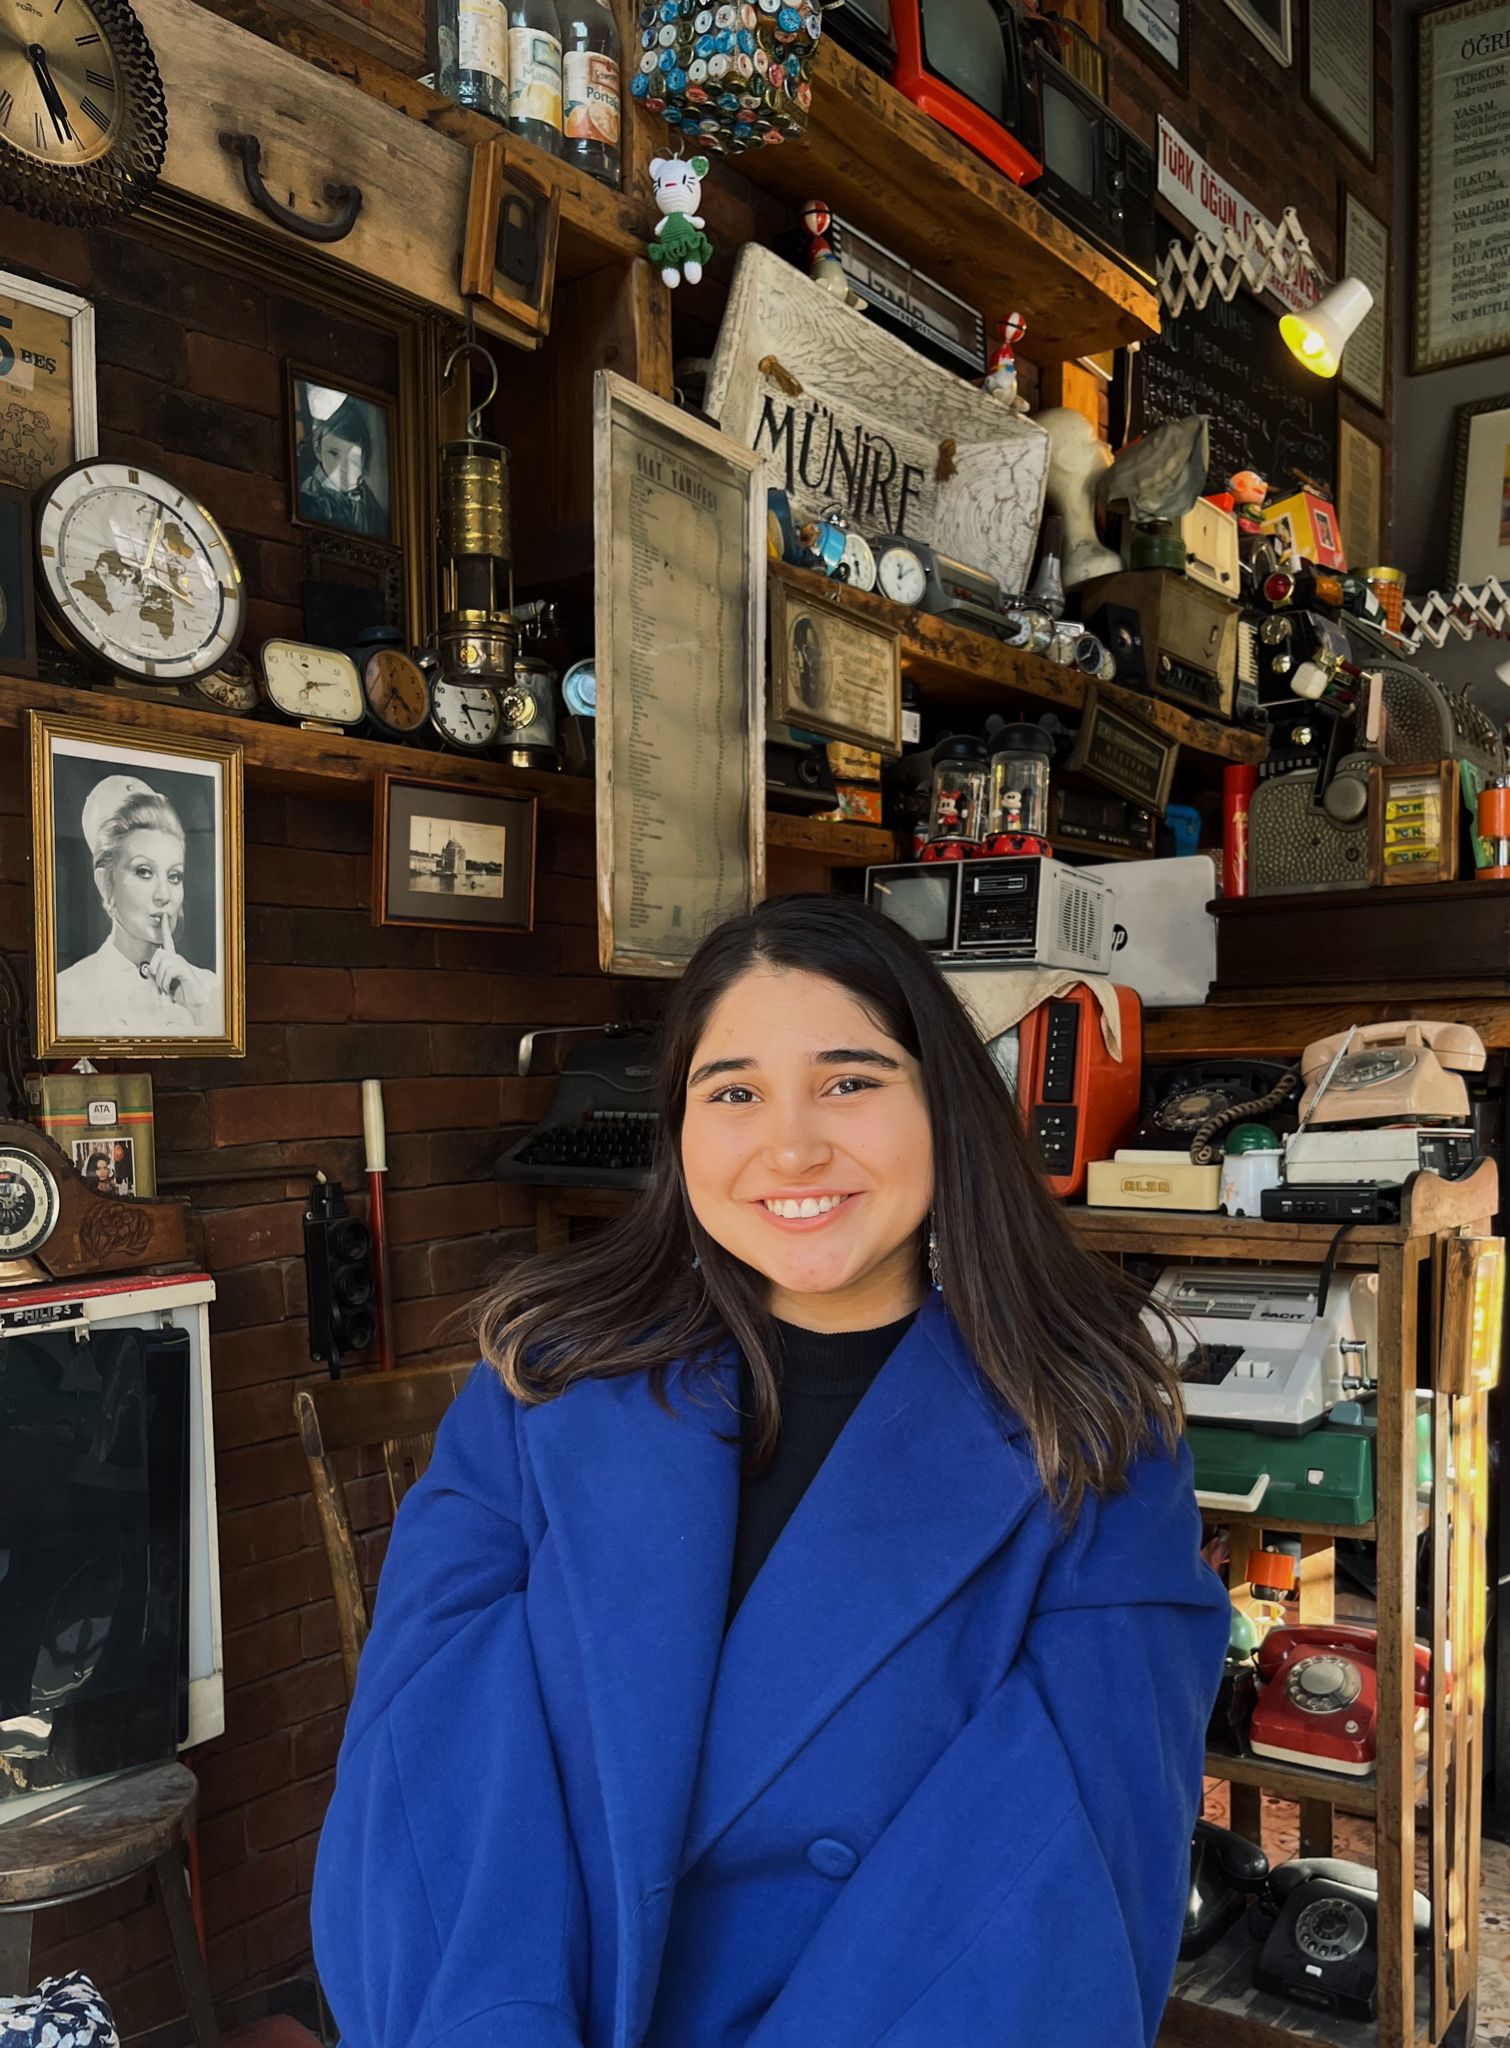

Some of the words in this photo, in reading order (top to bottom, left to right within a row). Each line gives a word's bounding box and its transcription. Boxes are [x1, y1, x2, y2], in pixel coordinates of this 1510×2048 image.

[1161, 127, 1195, 196] TÜRK
[20, 348, 57, 375] BEŞ
[93, 1104, 111, 1113] ATA
[13, 1305, 72, 1322] PHILIPS
[1260, 1312, 1305, 1320] FACIT
